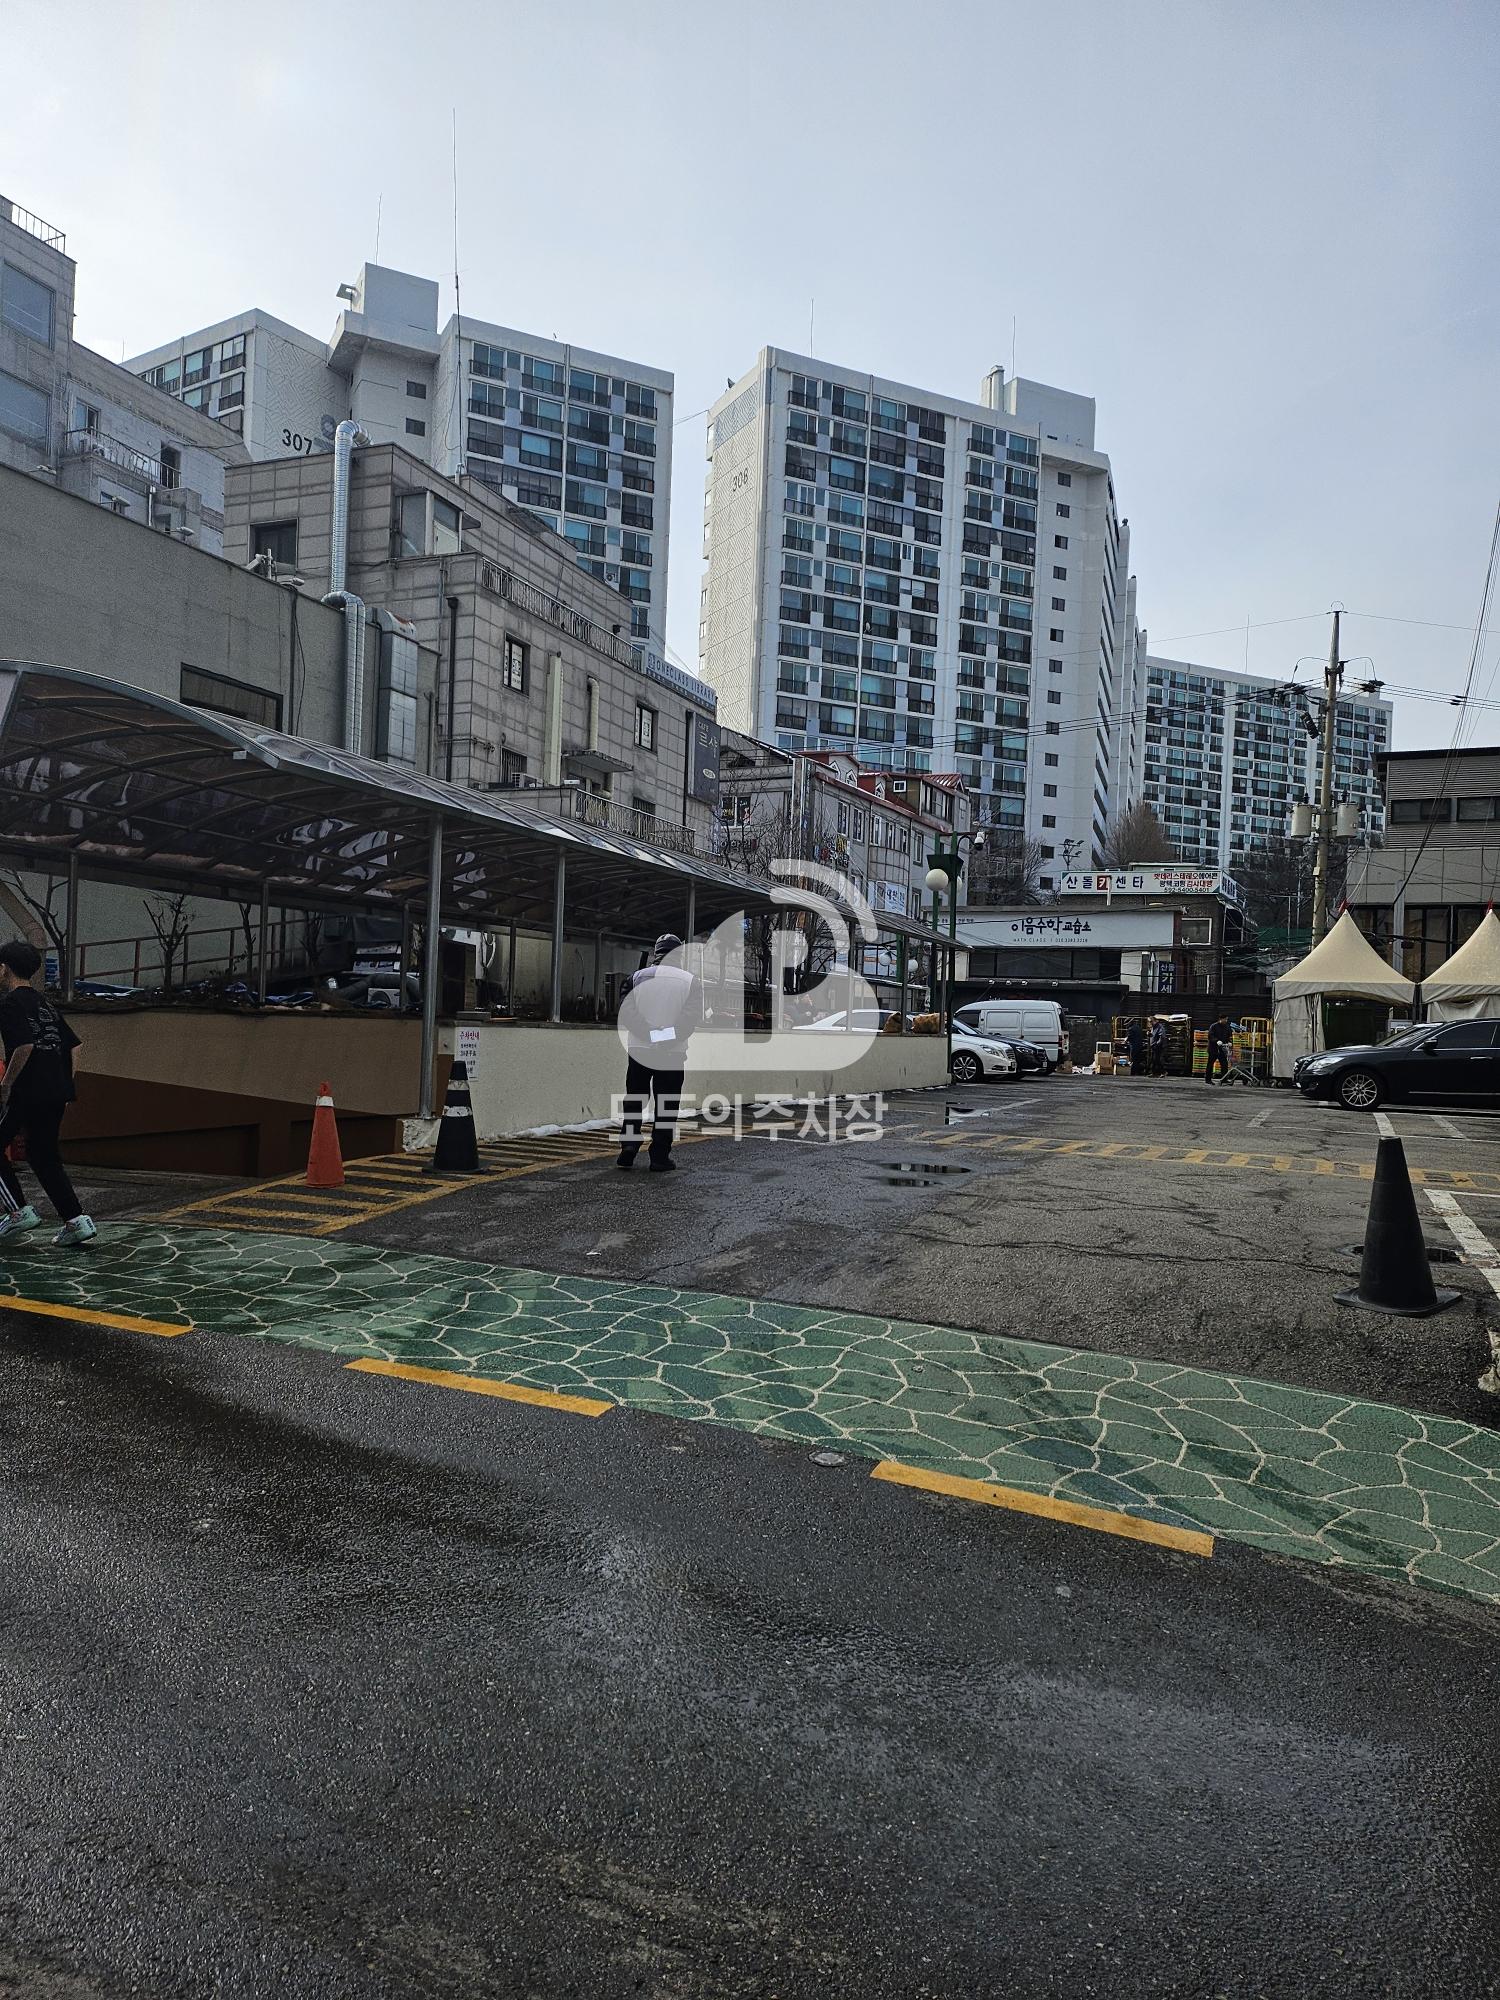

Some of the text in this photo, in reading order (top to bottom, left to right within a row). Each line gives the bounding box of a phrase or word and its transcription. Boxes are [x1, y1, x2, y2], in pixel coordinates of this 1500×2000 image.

[281, 428, 313, 455] 307
[1011, 917, 1091, 935] 이음수학 교습소
